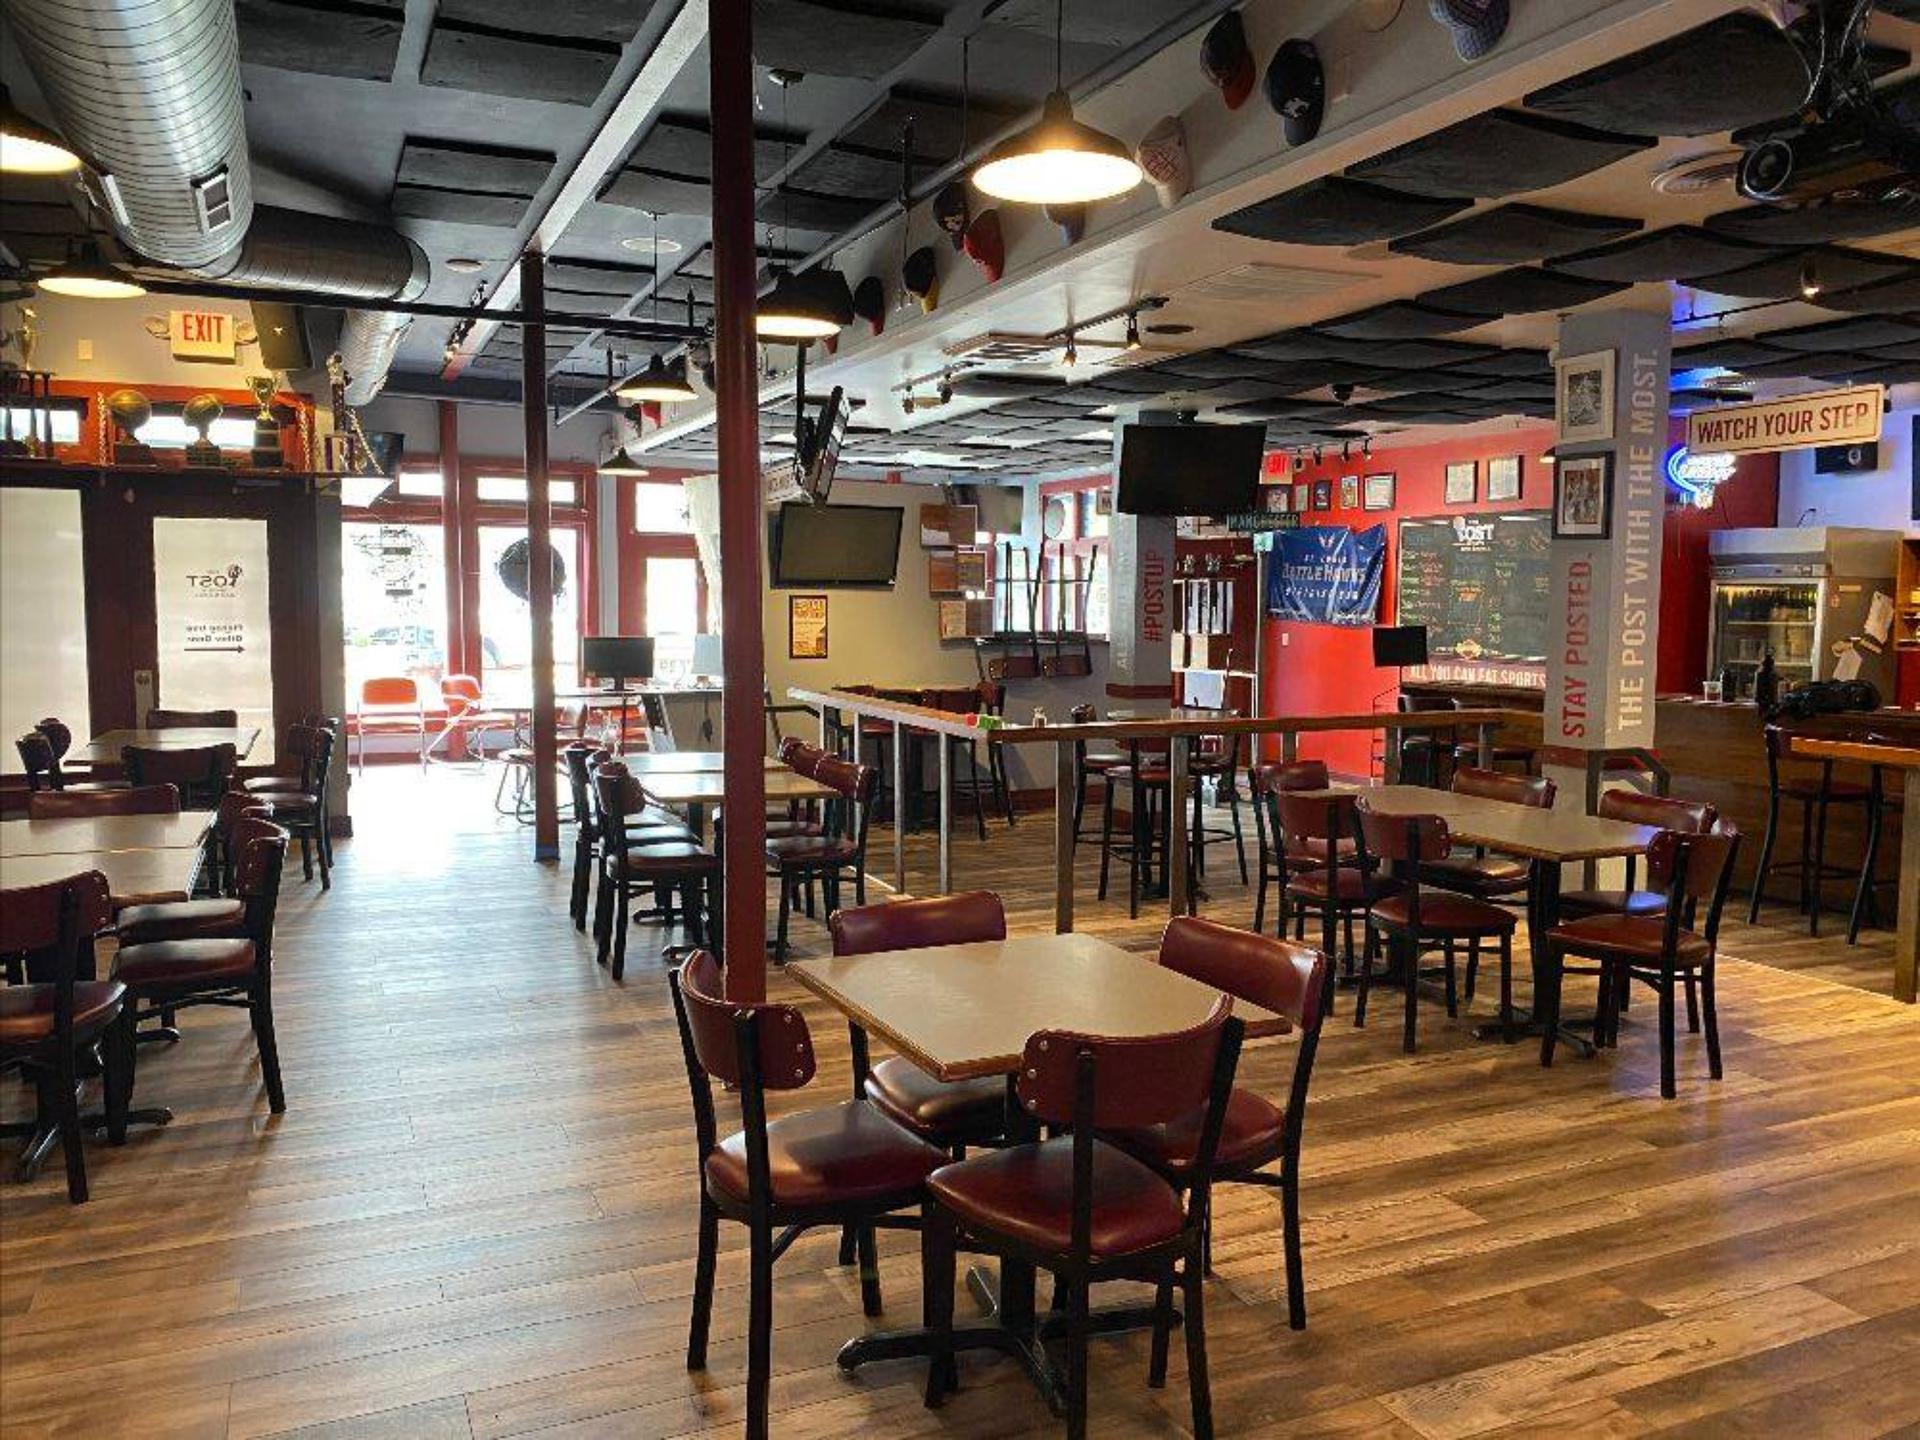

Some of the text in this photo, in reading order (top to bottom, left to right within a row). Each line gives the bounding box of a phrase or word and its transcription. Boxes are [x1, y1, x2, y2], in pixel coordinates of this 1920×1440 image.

[183, 314, 224, 344] EXIT
[1698, 402, 1870, 444] WATCH YOUR STEP
[1618, 350, 1658, 731] THE POST WITH THE MOST.
[1144, 551, 1165, 642] #POSTUP
[1410, 664, 1428, 681] ALL
[1430, 665, 1451, 681] YOU
[1454, 666, 1476, 683] CAN
[1500, 670, 1546, 689] SPORTS
[1562, 552, 1593, 738] STAY POSTED.
